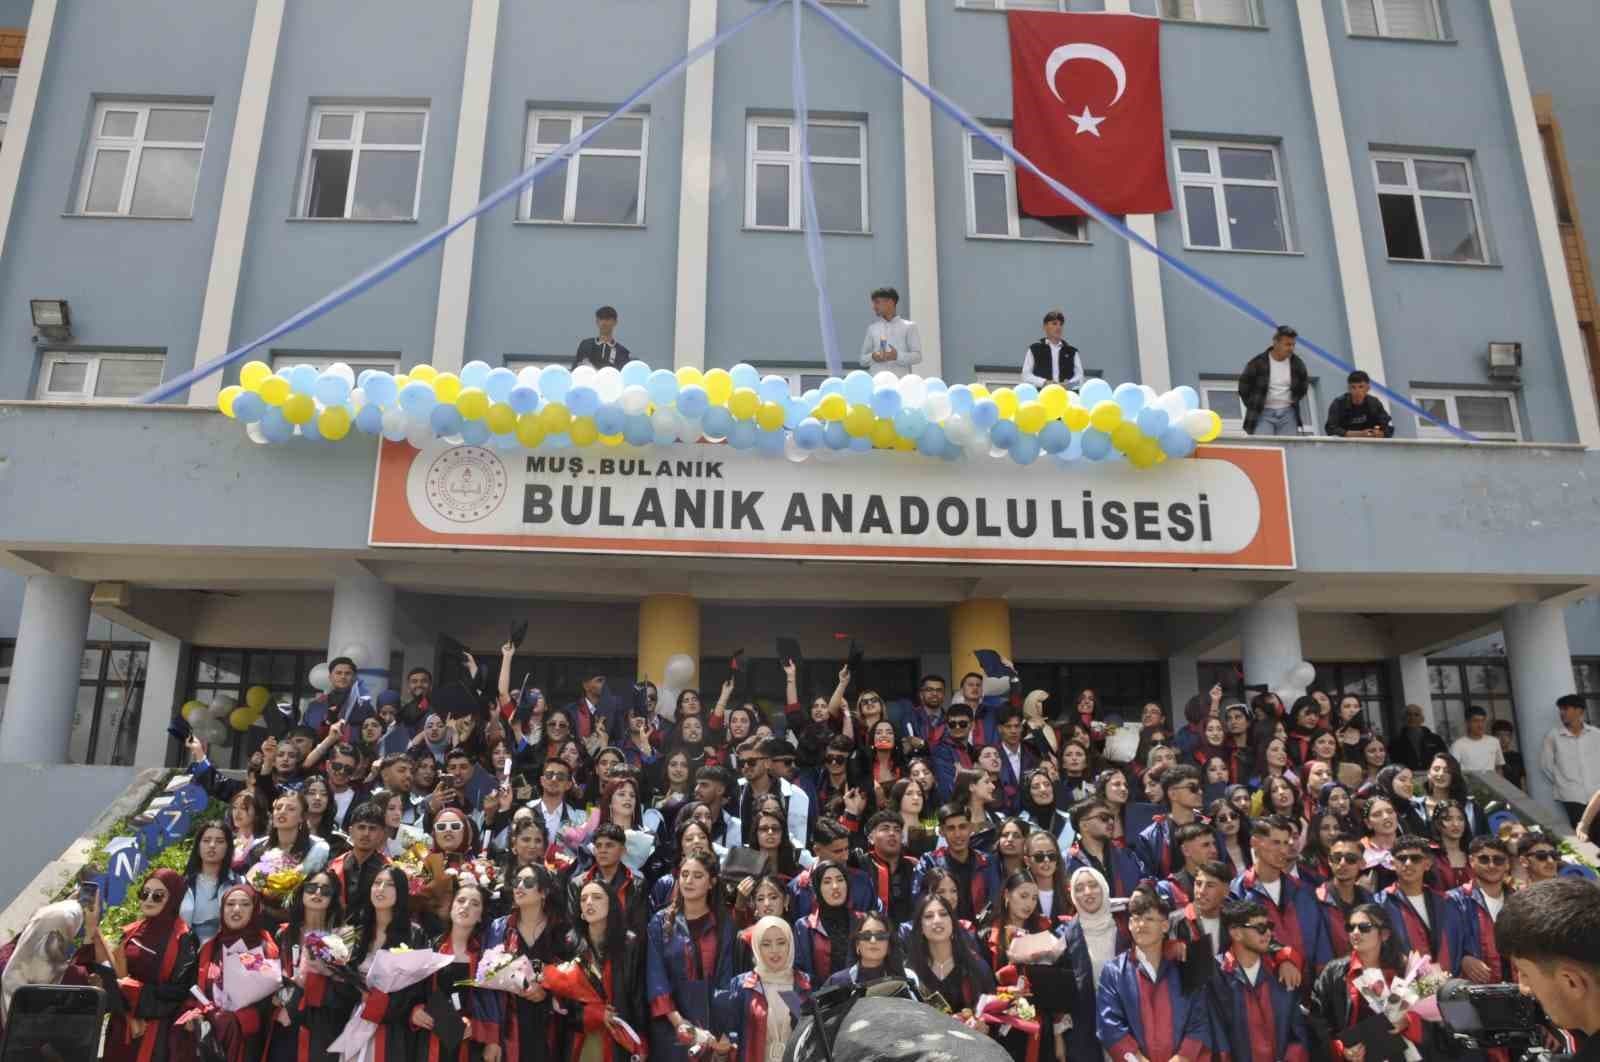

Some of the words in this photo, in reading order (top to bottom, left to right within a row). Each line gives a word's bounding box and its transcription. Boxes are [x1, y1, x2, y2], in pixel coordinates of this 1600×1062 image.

[522, 483, 766, 531] BULANIK
[781, 492, 1038, 538] ANADOLU
[1051, 490, 1213, 543] LİSESİ
